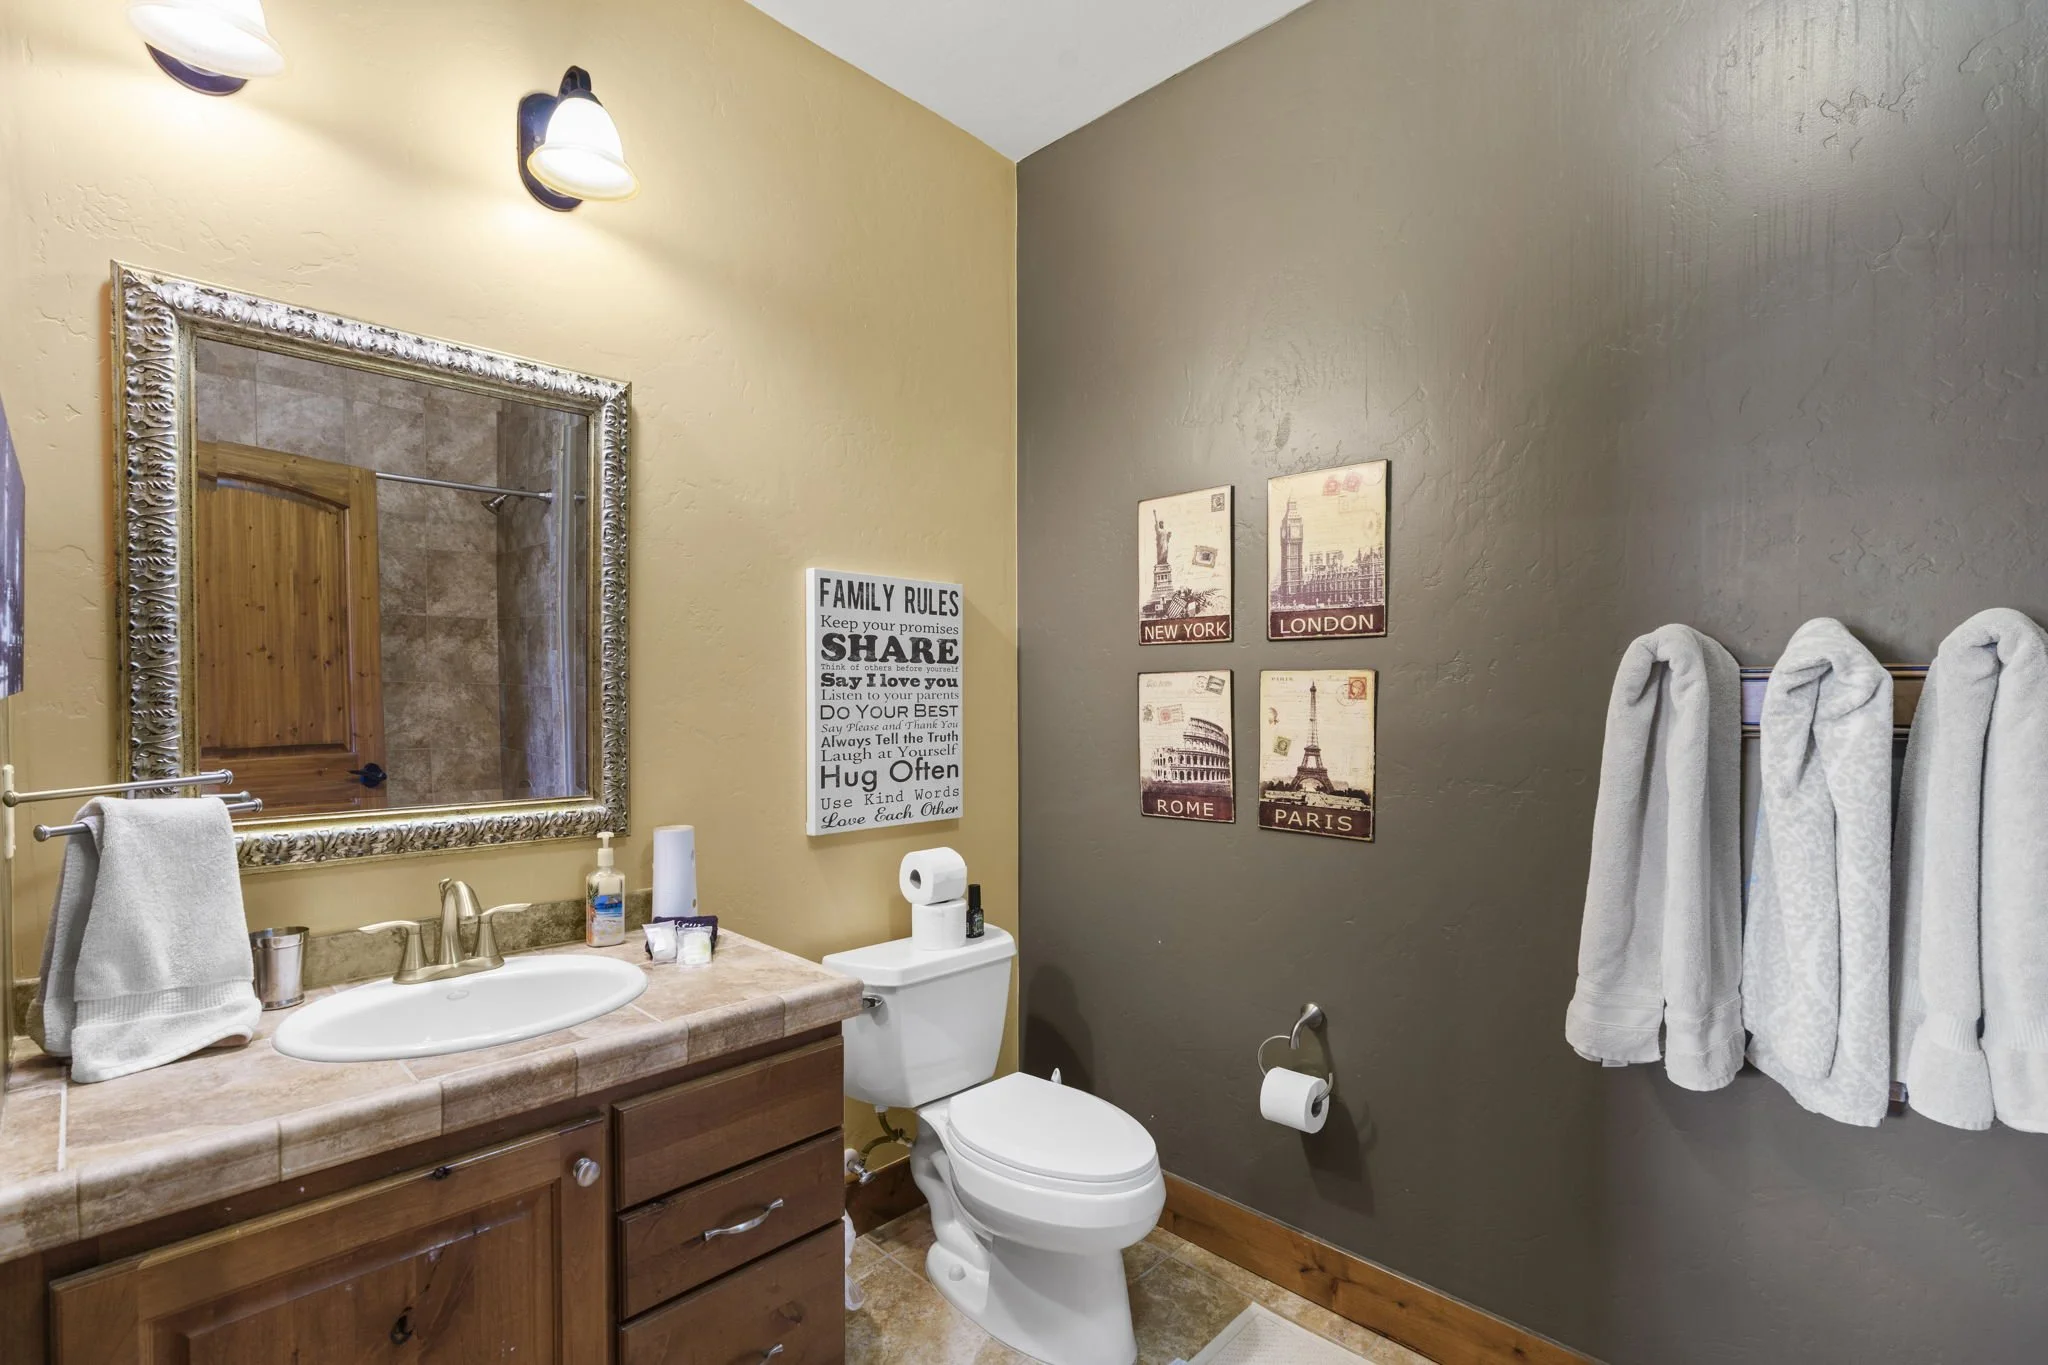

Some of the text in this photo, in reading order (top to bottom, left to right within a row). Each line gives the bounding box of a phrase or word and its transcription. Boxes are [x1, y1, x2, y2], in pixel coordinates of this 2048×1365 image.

[820, 577, 959, 617] FAMILY RULES
[820, 614, 959, 635] Keep your promises
[1144, 621, 1227, 640] NEW YORK
[1280, 614, 1374, 634] LONDON
[821, 632, 959, 665] SHARE
[821, 663, 846, 671] Think
[850, 663, 860, 671] of
[896, 664, 923, 672] before
[820, 672, 959, 690] Say I love you
[822, 689, 959, 703] Listen to your parents
[820, 719, 959, 735] Say Please and Thank You
[820, 731, 959, 749] Always Tell the Truth
[821, 743, 958, 764] Laugh at Yourself
[820, 757, 959, 792] Hug Often
[820, 786, 960, 810] Use Kind Words
[1157, 799, 1214, 817] ROME
[821, 800, 959, 829] Love Each Other
[1275, 809, 1353, 832] PARIS
